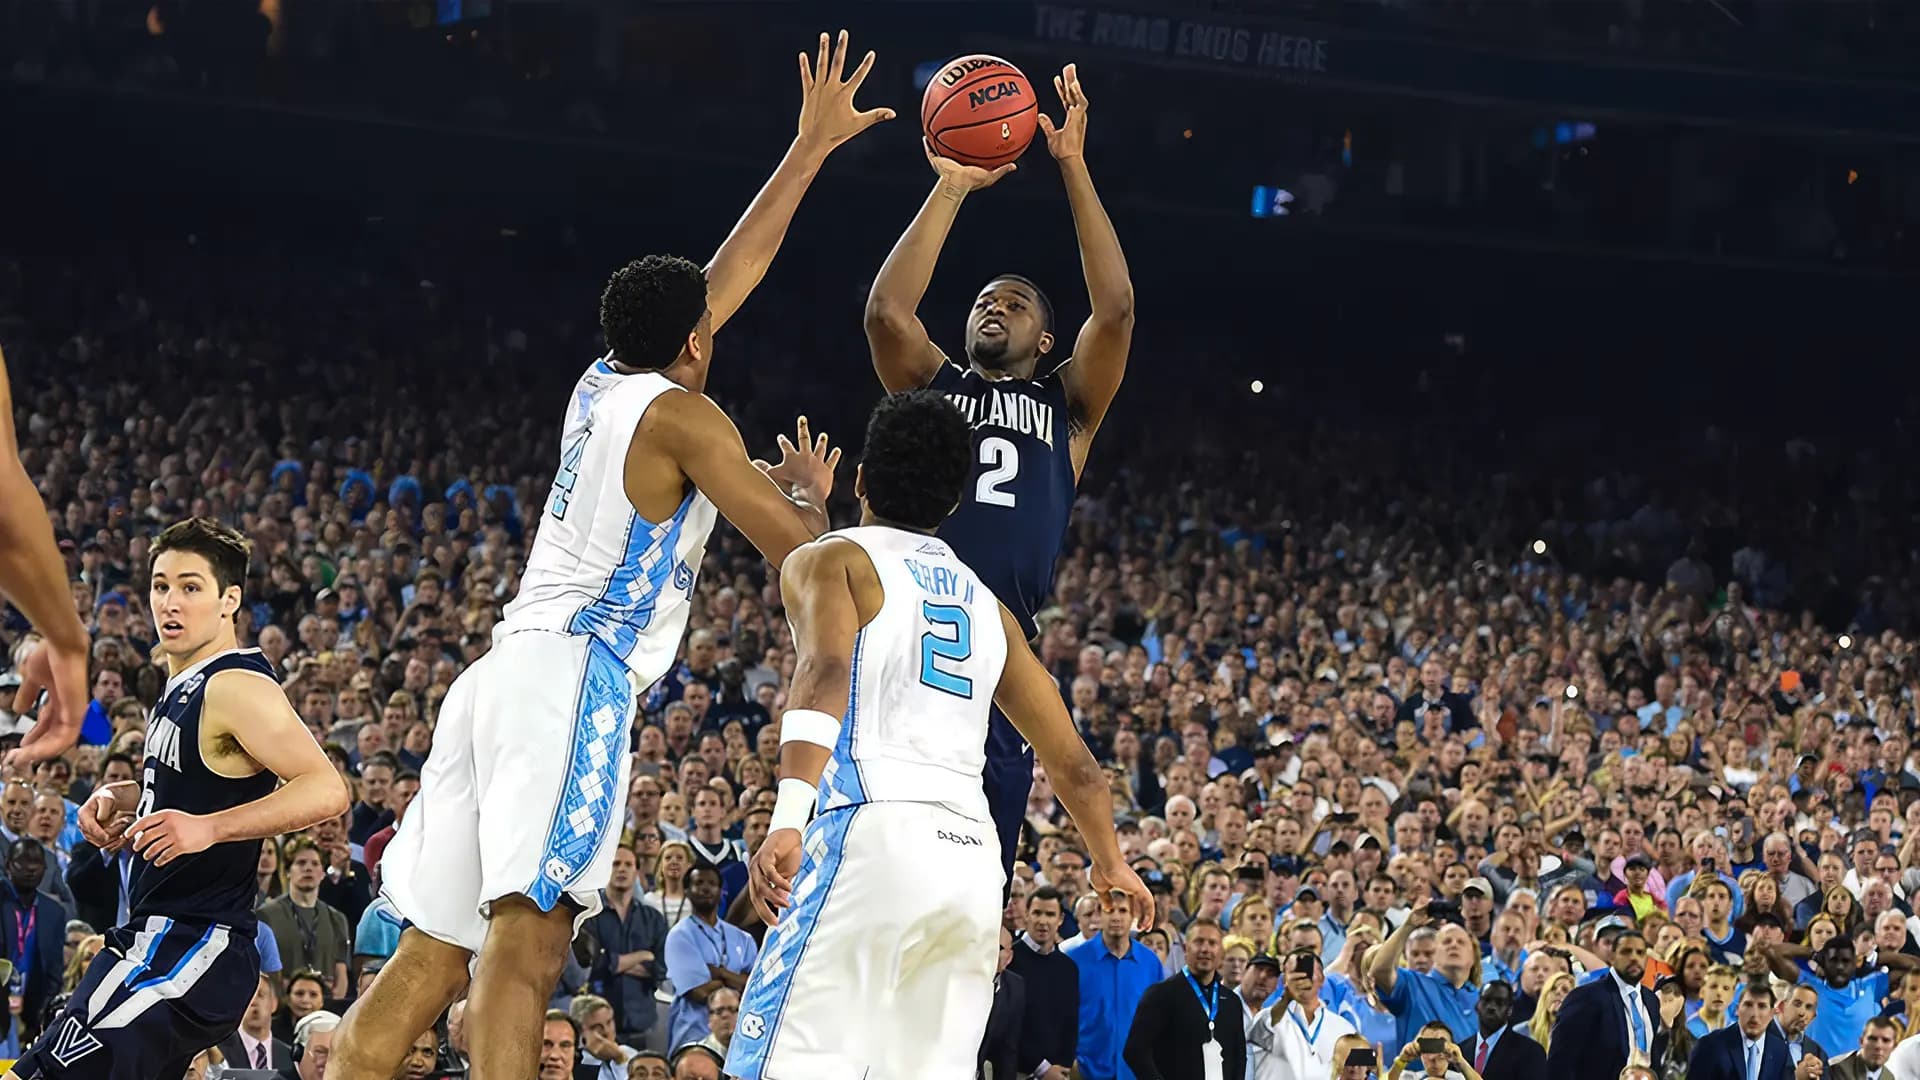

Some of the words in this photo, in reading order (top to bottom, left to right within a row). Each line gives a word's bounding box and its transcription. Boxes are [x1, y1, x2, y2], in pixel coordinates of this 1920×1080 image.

[1036, 5, 1087, 41] THE
[1092, 12, 1169, 51] ROAD
[1256, 32, 1329, 72] HERE
[968, 81, 1021, 109] NCAA
[974, 435, 1019, 508] 2
[919, 600, 972, 700] 2
